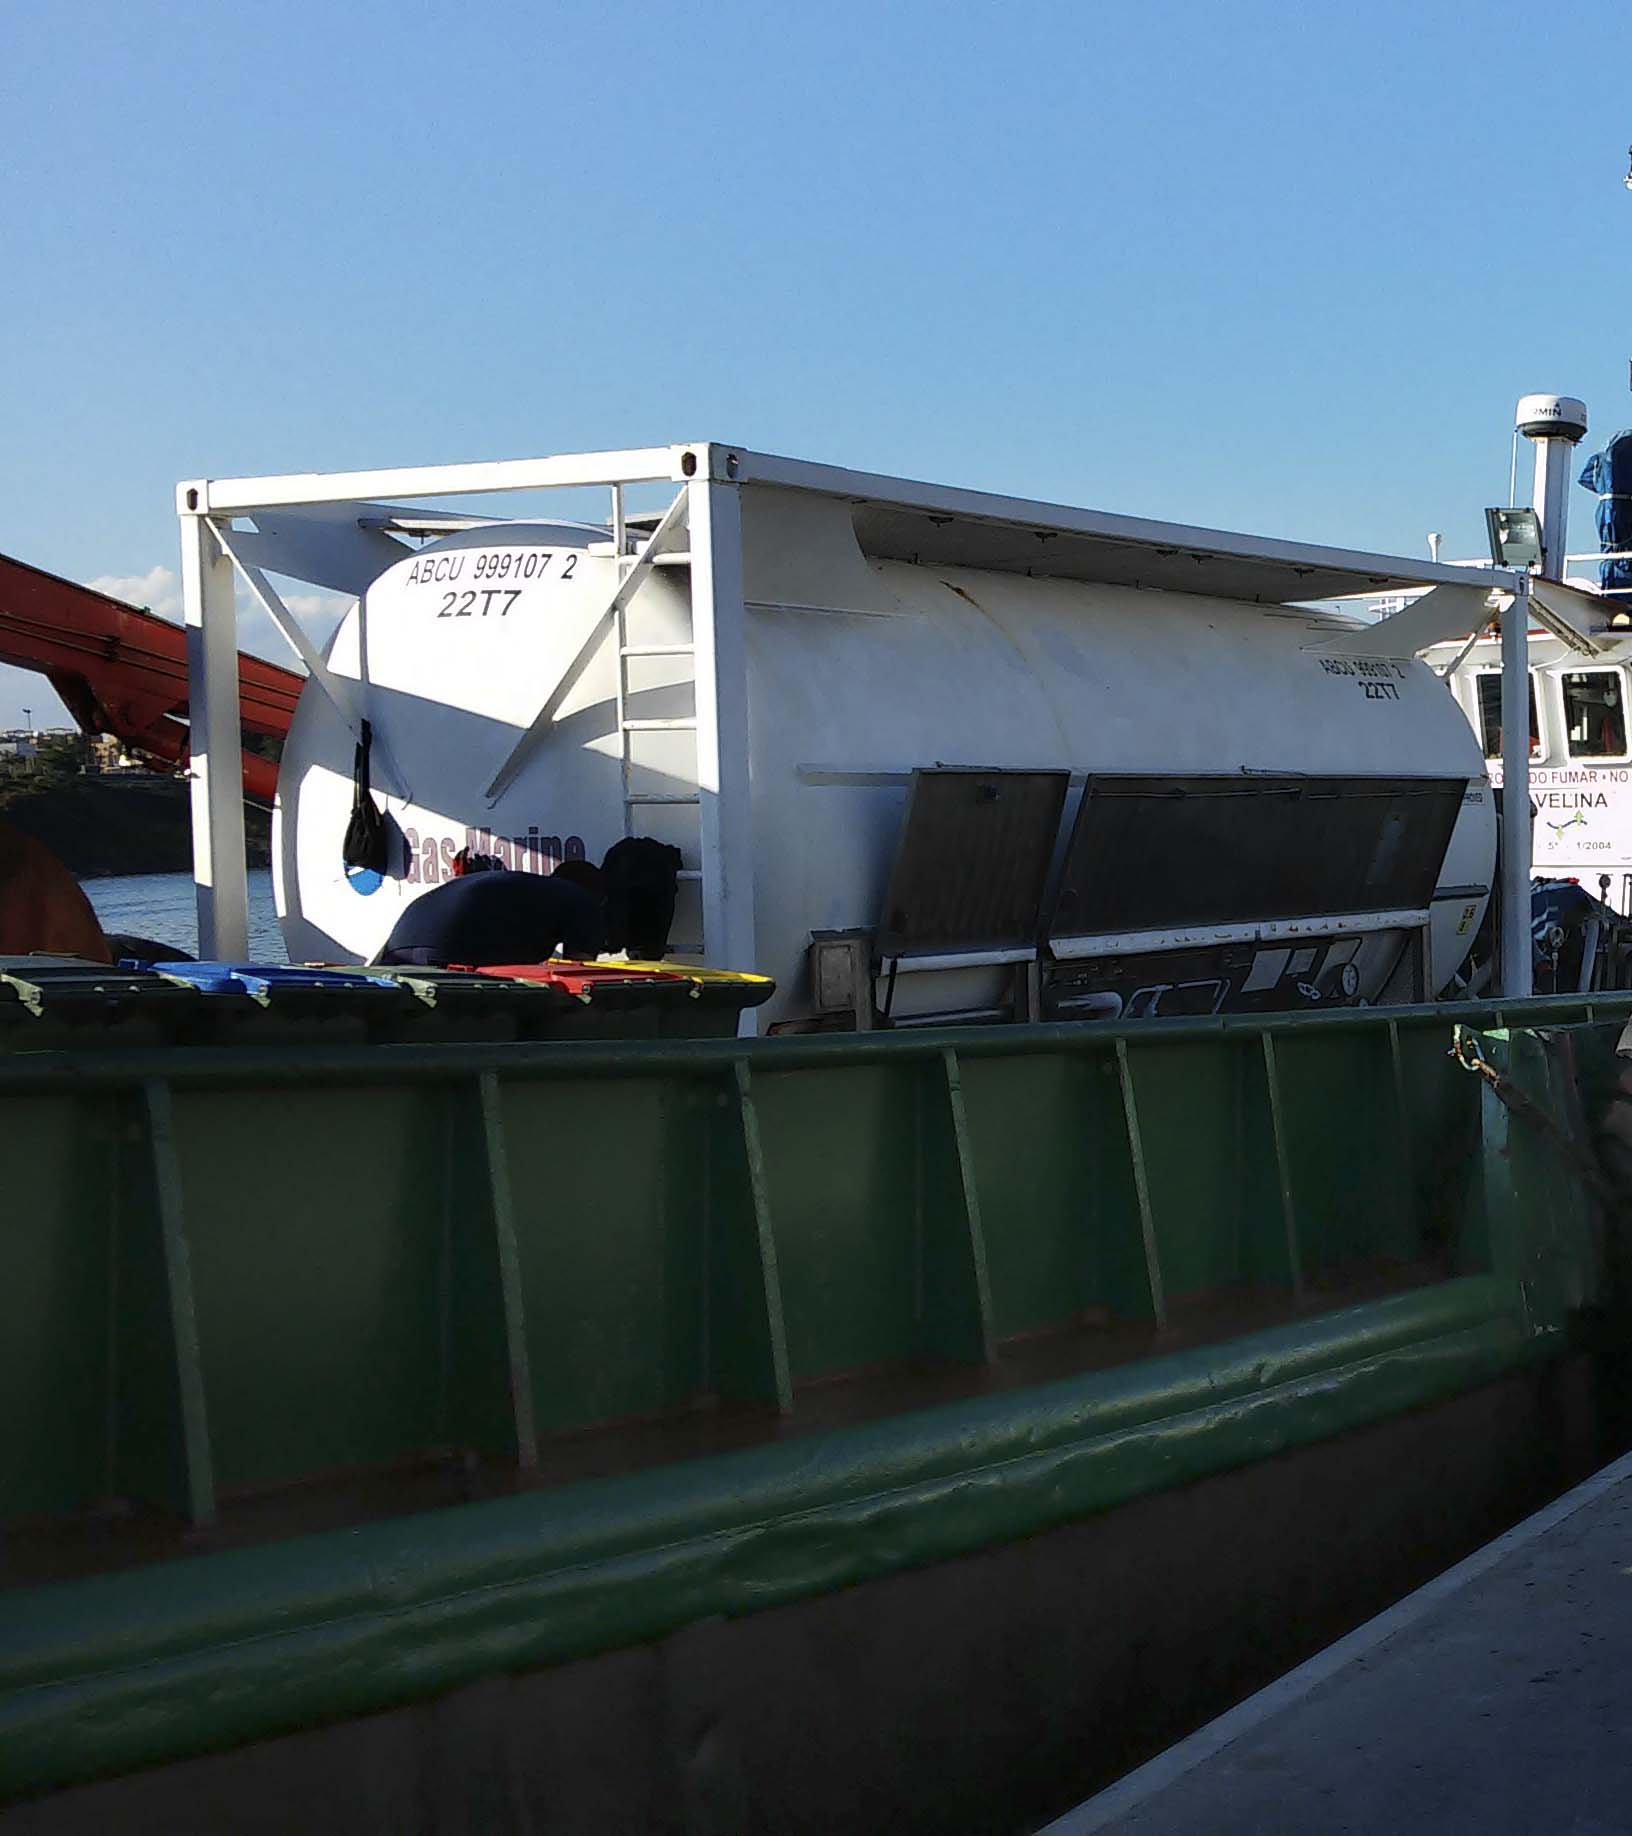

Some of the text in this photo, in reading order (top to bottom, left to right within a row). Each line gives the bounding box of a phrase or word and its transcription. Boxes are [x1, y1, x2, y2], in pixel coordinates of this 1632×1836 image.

[405, 553, 579, 586] ABCU 999107 2
[436, 589, 523, 618] 22T7
[1551, 770, 1598, 784] FUMAR
[1609, 770, 1629, 783] NO
[1535, 792, 1609, 808] VELINA
[404, 827, 457, 884] Gas
